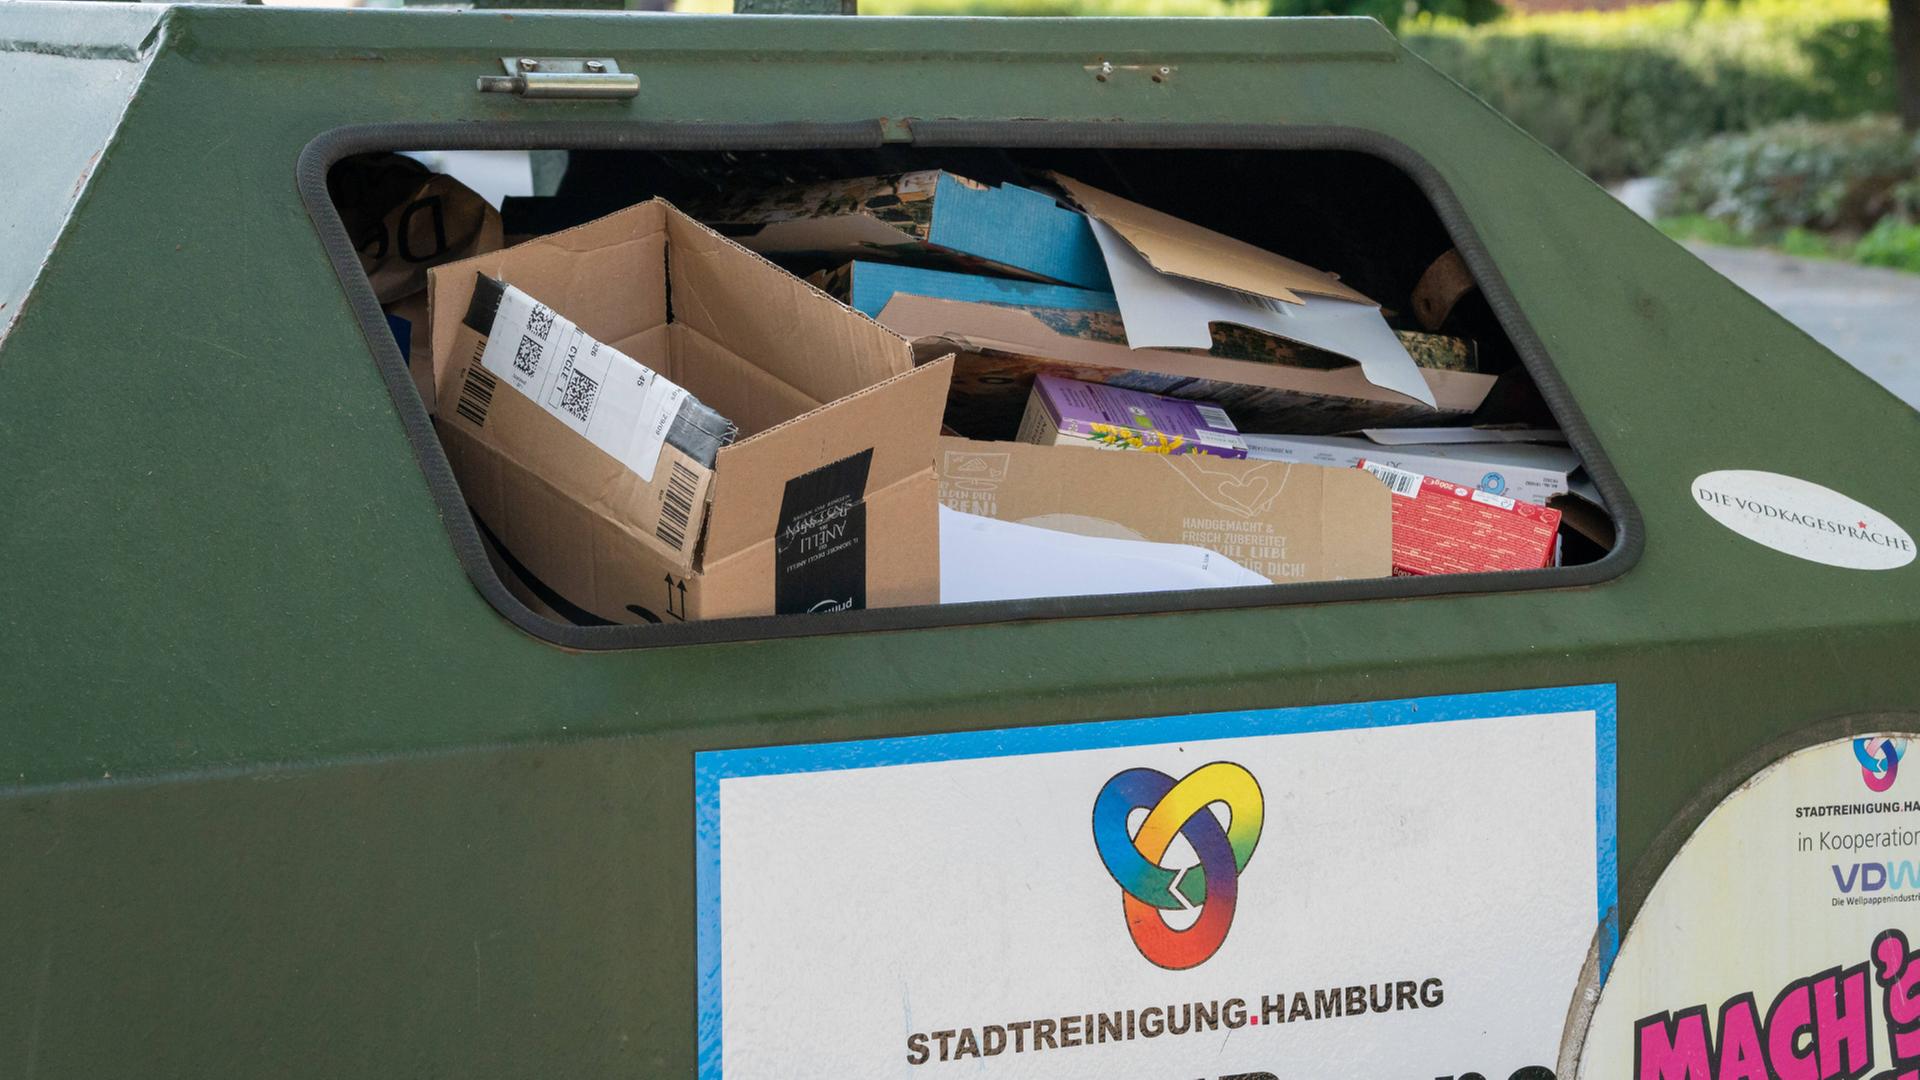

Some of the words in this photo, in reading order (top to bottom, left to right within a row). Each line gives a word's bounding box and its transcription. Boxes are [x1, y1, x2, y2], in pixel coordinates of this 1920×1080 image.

[559, 345, 578, 381] CYCLE
[636, 374, 647, 387] 45
[1433, 478, 1454, 492] 200g
[1699, 488, 1732, 507] DIE
[1182, 517, 1263, 533] HANDGEMACHT
[1265, 523, 1275, 534] &
[800, 519, 847, 554] ANELLI
[1181, 530, 1221, 543] FRISCH
[1224, 533, 1288, 547] ZUBEREITET
[1250, 546, 1288, 560] LIEBE
[1267, 561, 1305, 577] DICH!
[1798, 831, 1813, 852] in
[1831, 897, 1845, 907] Die
[906, 977, 1445, 1066] STADTREINIGUNG.HAMBURG
